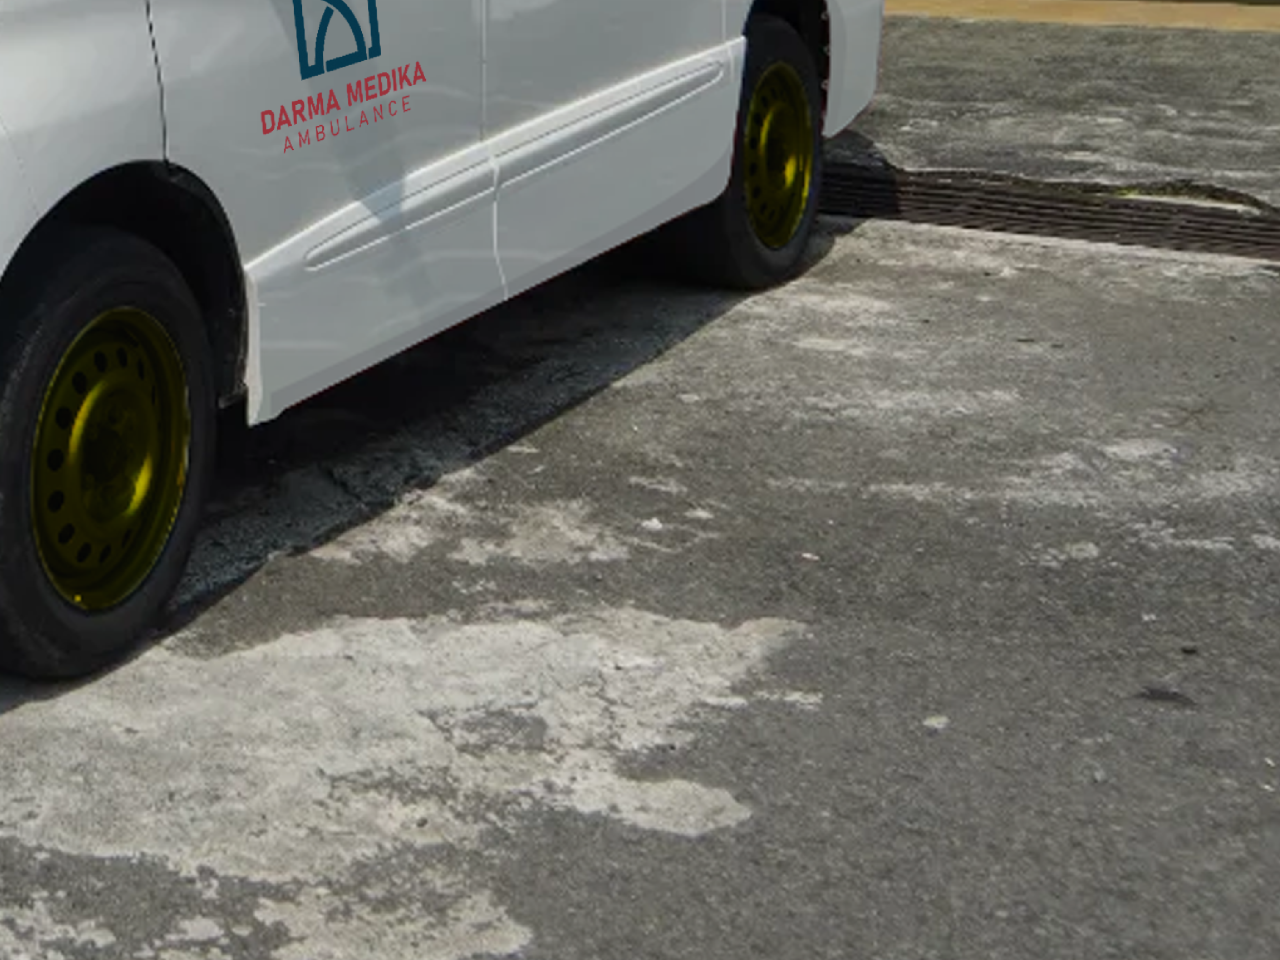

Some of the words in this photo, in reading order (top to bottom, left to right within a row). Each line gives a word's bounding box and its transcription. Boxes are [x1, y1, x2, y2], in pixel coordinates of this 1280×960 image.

[260, 89, 341, 135] DARMA
[346, 61, 427, 107] MEDIKA
[283, 95, 412, 154] AMBULANCE
